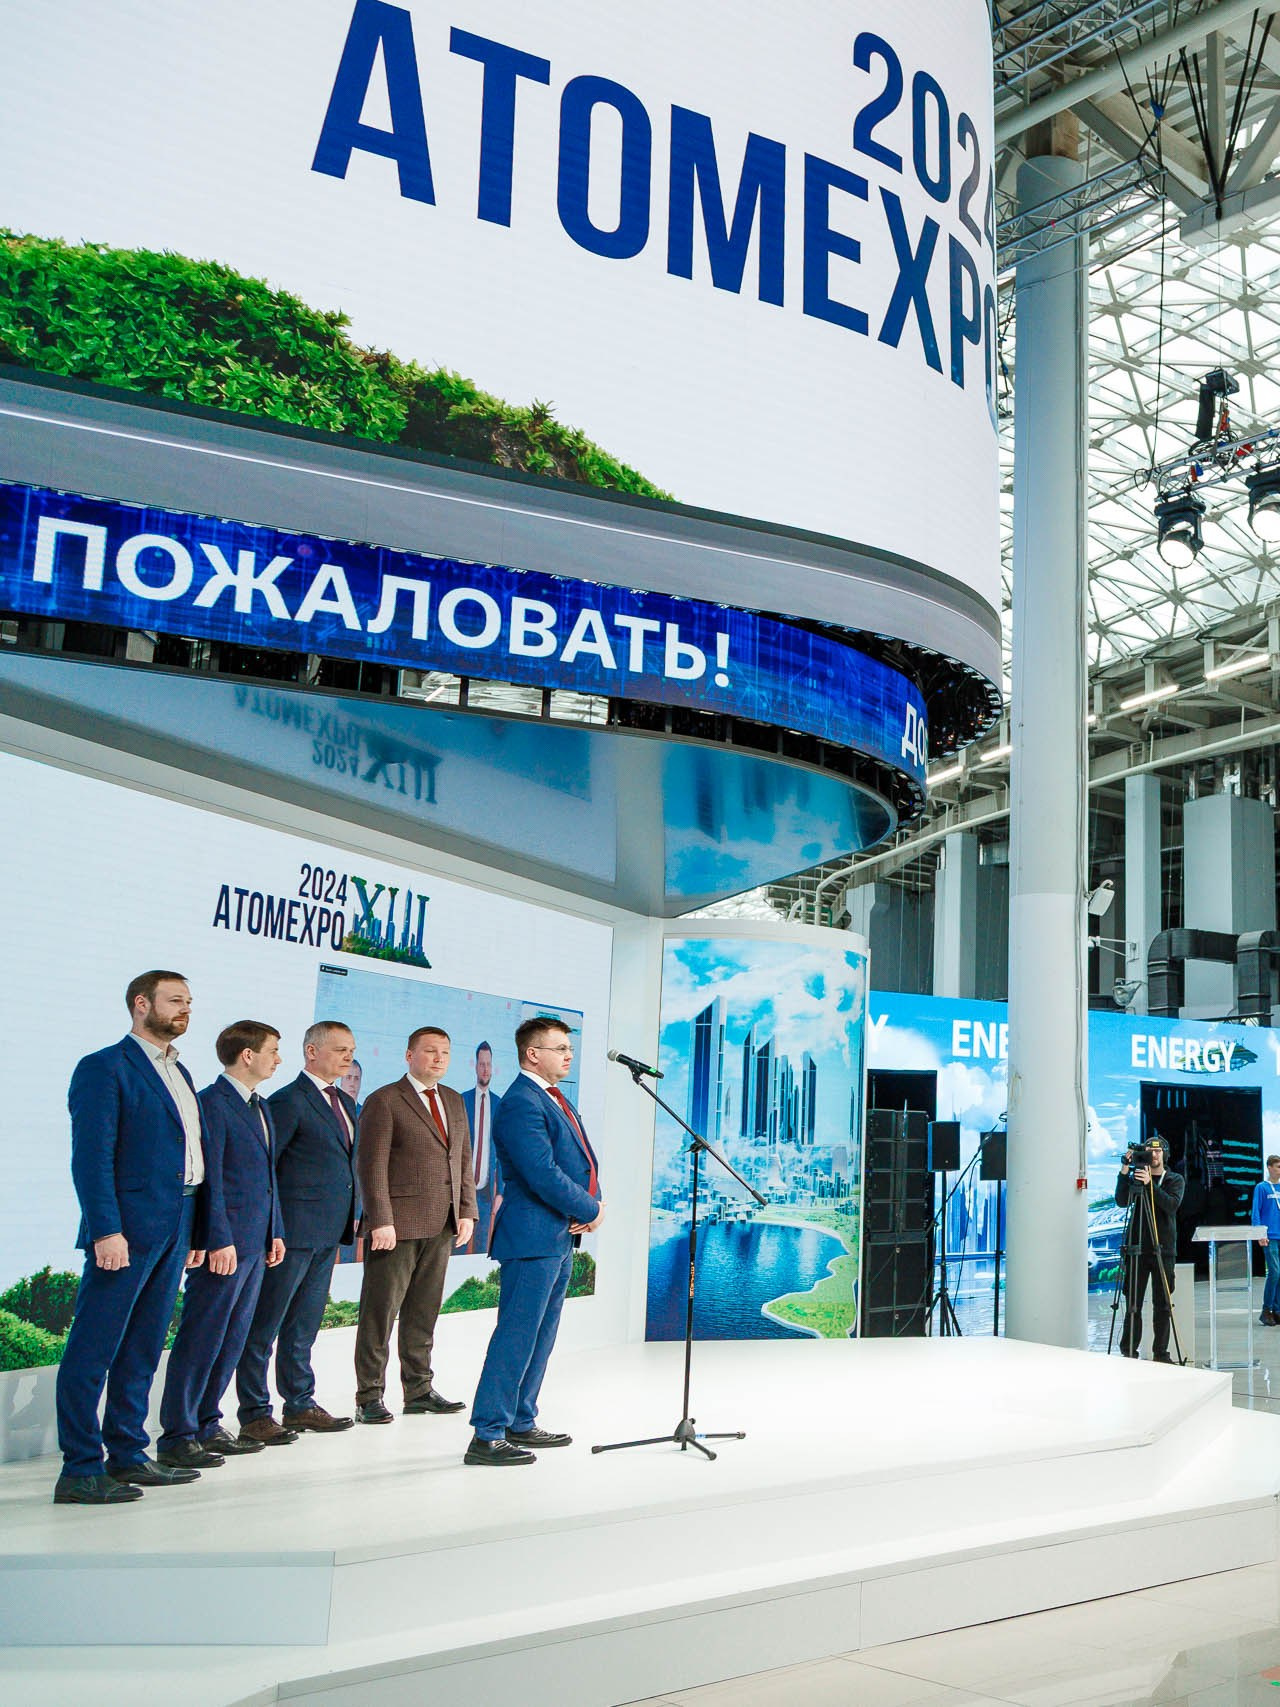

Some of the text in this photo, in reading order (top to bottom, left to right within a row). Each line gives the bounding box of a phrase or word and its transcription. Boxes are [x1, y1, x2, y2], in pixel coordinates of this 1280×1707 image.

[311, 0, 999, 439] ATOMEXPO
[33, 515, 731, 688] ПОЖАЛОВАТЬ!
[902, 702, 928, 782] ДО
[212, 884, 346, 951] ATOMEXPO
[299, 863, 348, 907] 2024
[1131, 1034, 1236, 1073] ENERGY
